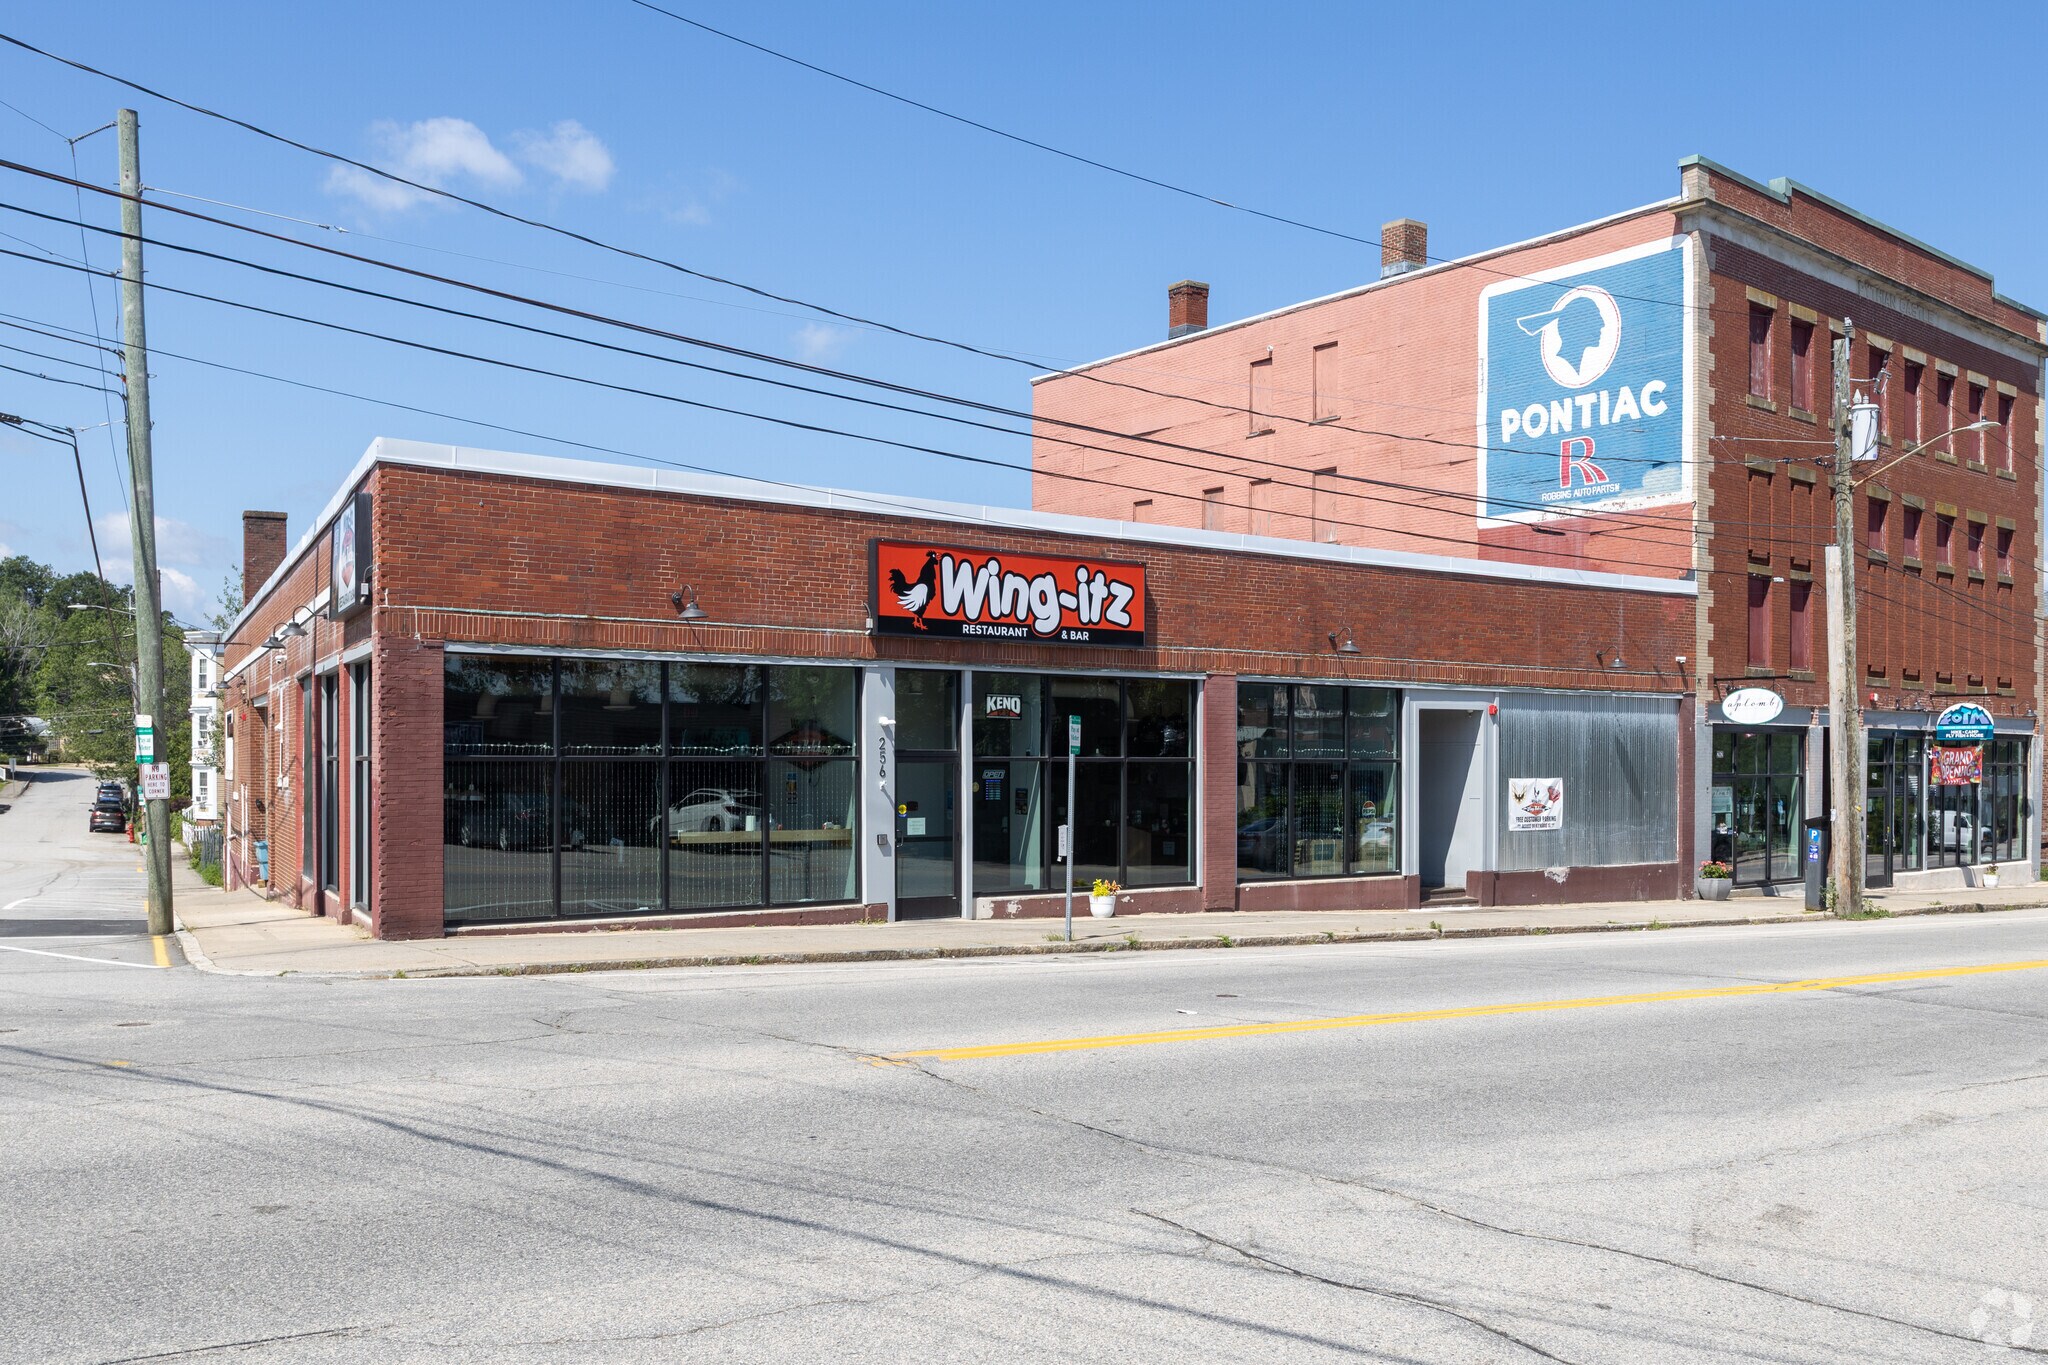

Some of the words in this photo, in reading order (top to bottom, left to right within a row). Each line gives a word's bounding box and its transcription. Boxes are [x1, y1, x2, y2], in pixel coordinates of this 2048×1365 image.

[1501, 380, 1668, 443] PONTIAC
[1560, 436, 1609, 488] R
[1541, 489, 1572, 502] ROBBINS
[1573, 486, 1592, 498] AUTO
[1592, 483, 1615, 495] PARTS
[940, 554, 1134, 634] Wing-itz
[962, 624, 1028, 637] RESTAURANT
[1061, 630, 1068, 640] &
[1070, 631, 1089, 641] BAR
[986, 696, 1021, 714] KENO
[1727, 694, 1778, 714] aplomb
[1944, 751, 1973, 765] GRAND
[151, 765, 160, 773] NO
[984, 770, 1004, 779] OPEN
[1942, 764, 1973, 779] OPENING
[1811, 830, 1818, 840] P
